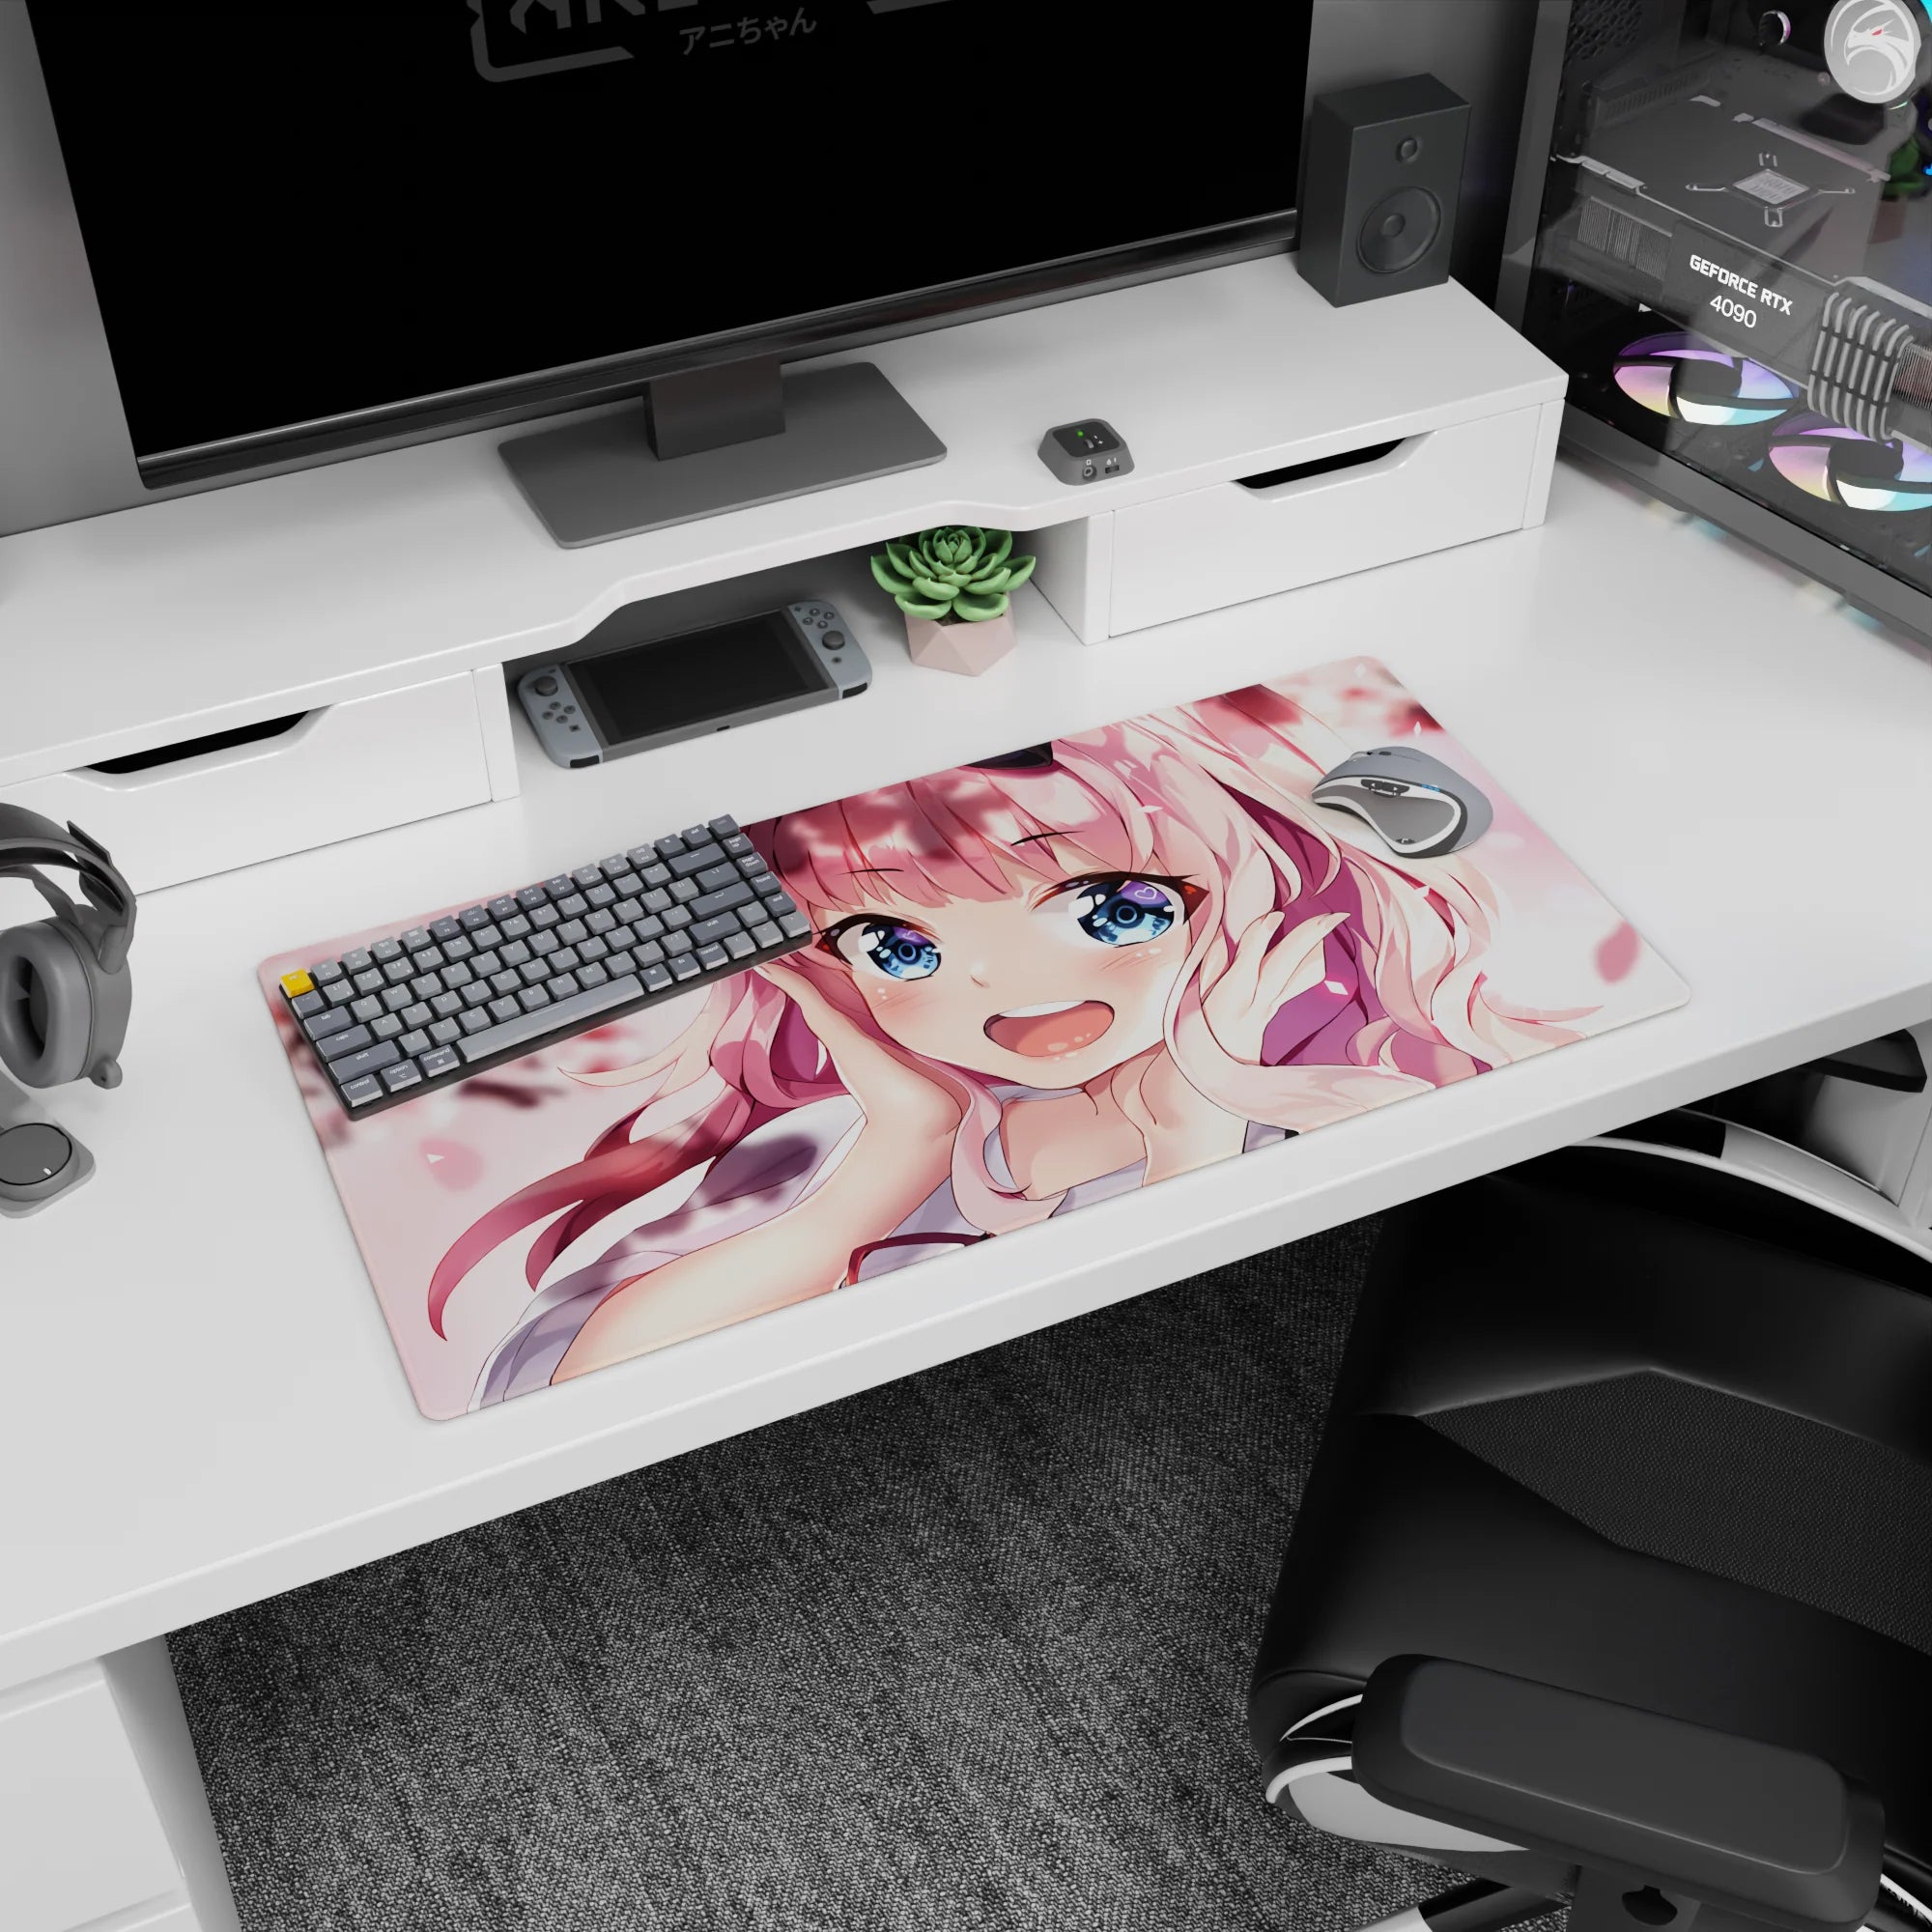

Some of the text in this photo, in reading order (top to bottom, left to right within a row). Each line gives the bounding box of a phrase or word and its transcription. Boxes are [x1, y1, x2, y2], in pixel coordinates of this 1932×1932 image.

[679, 7, 817, 55] アニちゃん
[1690, 254, 1793, 315] GEFORCE RTX
[1710, 295, 1757, 328] 4090
[423, 1047, 451, 1061] command
